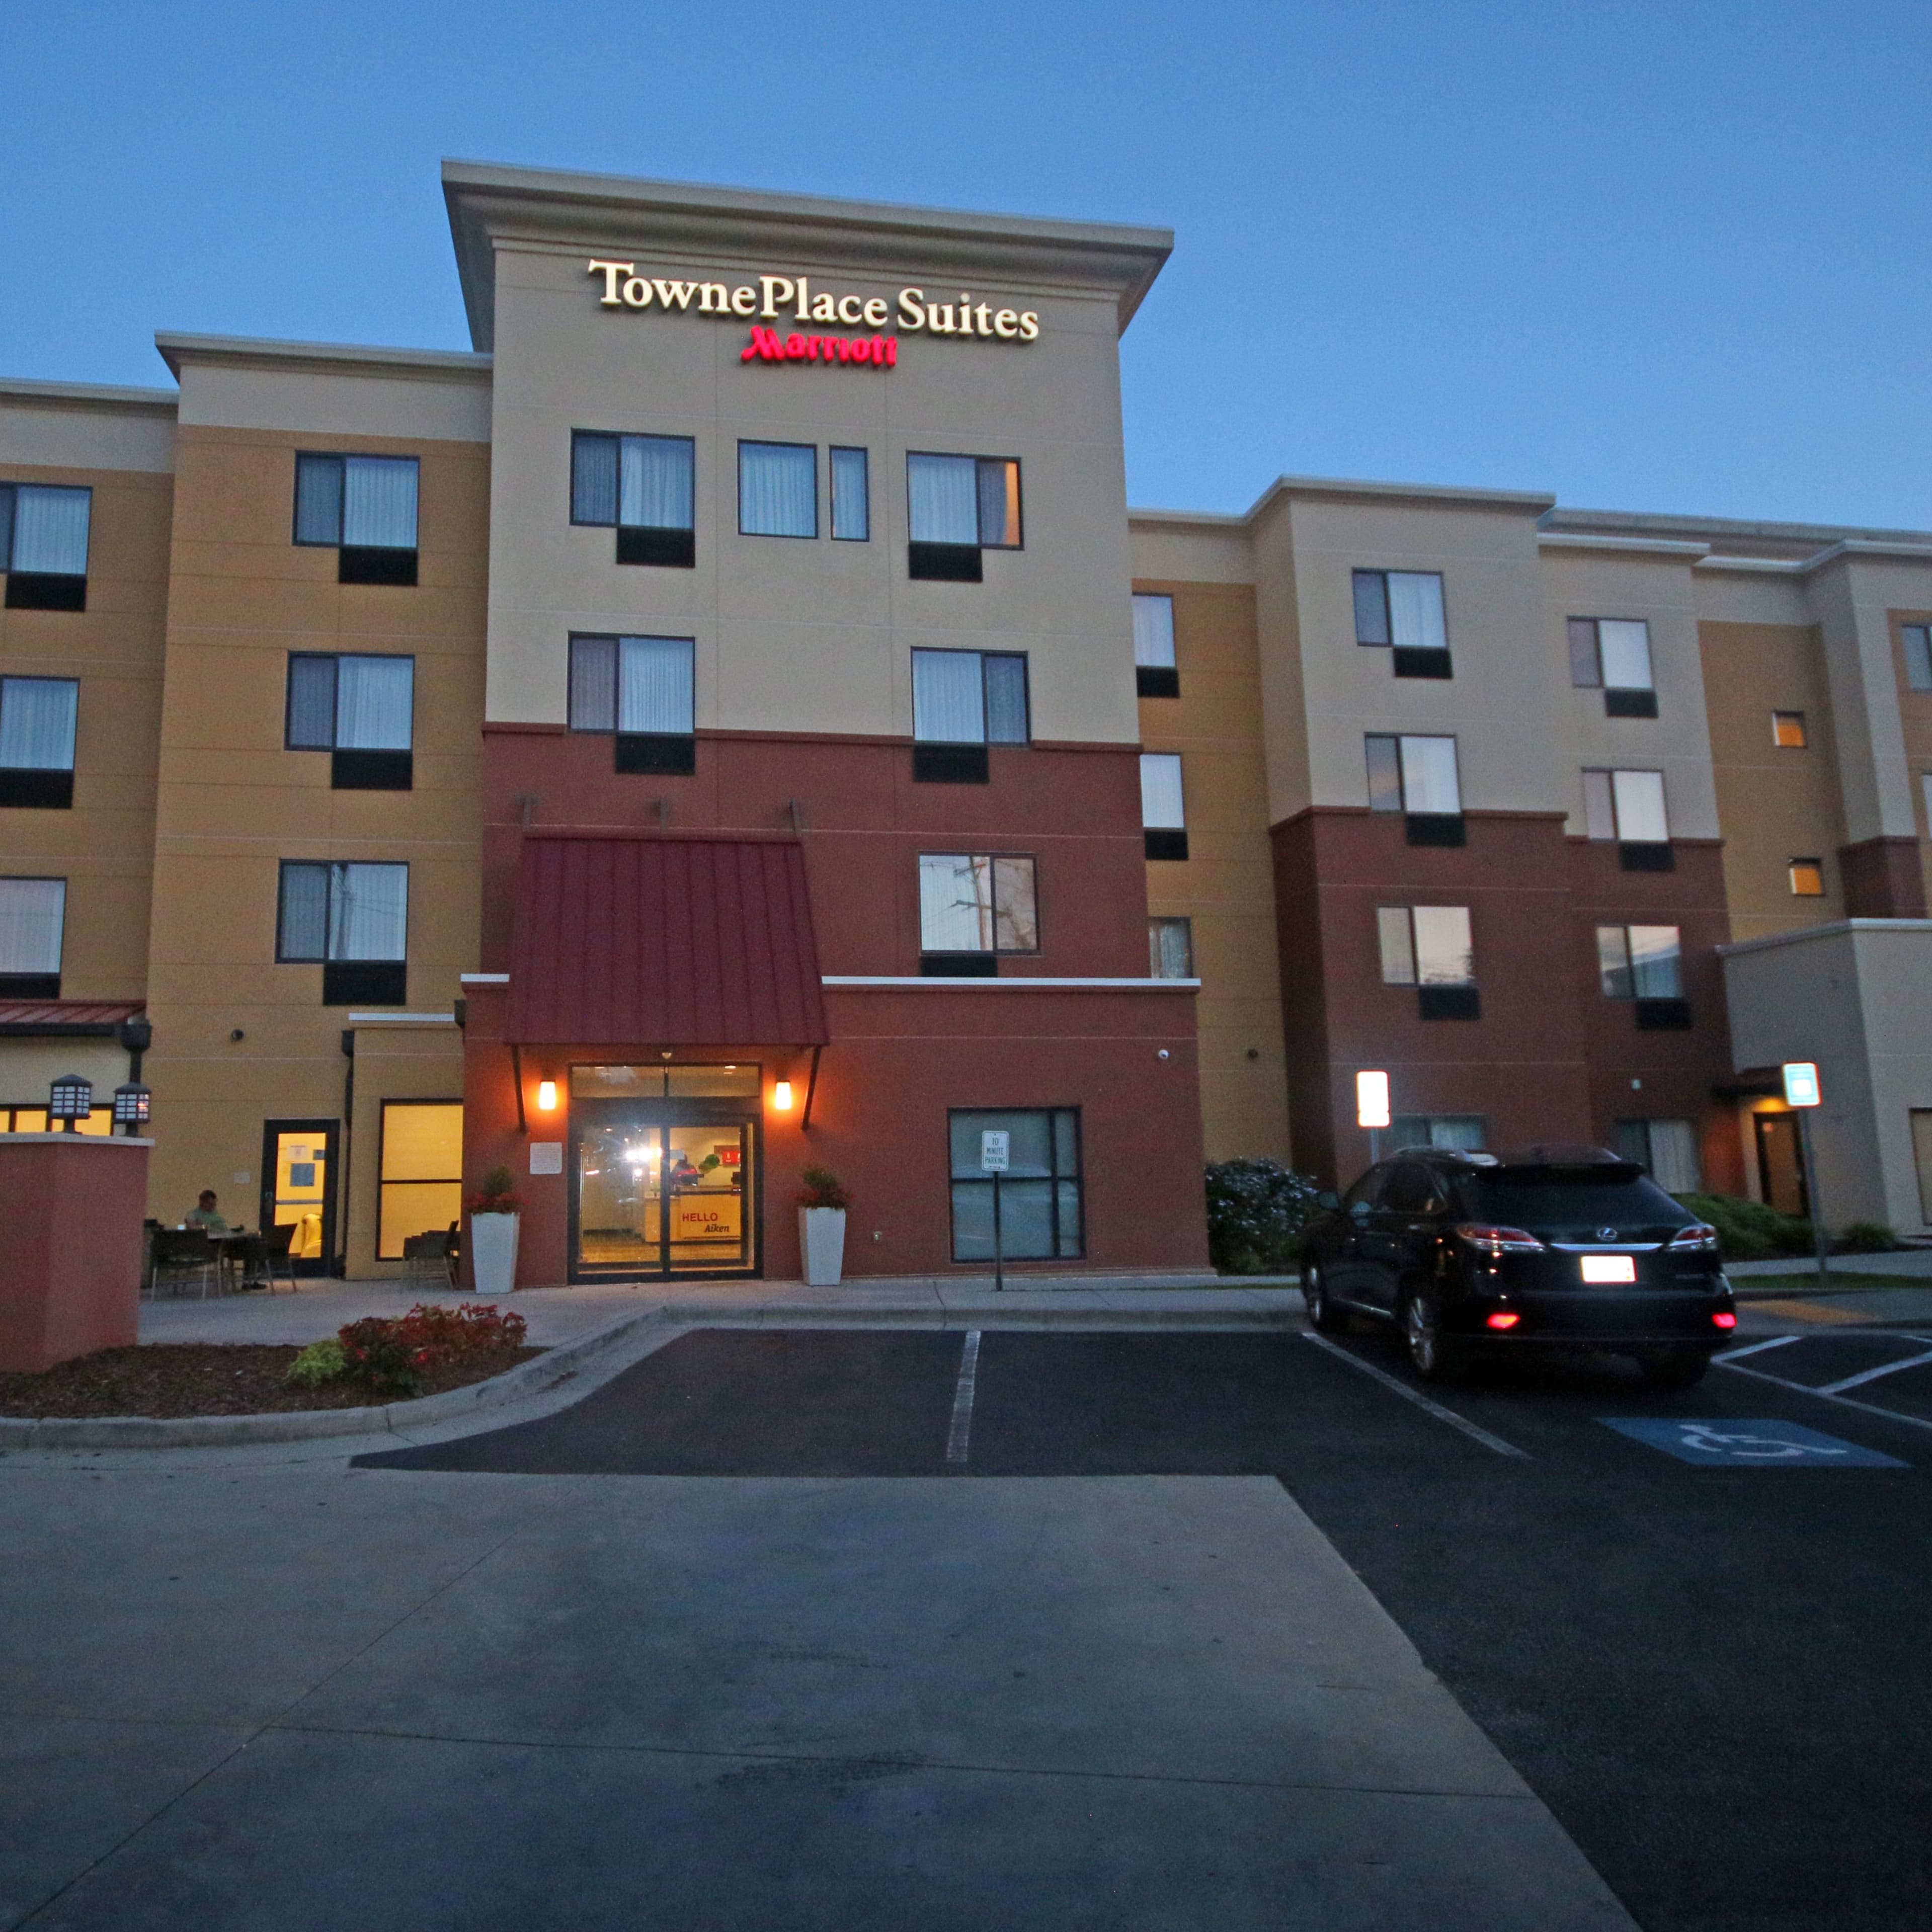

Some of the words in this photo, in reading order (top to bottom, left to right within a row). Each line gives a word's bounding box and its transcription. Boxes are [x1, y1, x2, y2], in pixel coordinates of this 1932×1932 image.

[588, 259, 888, 327] TownePlace
[898, 287, 1039, 340] Suites
[741, 325, 898, 367] Marriott
[992, 1138, 999, 1146] 10
[682, 1212, 718, 1222] HELLO
[704, 1224, 730, 1233] Aiken
